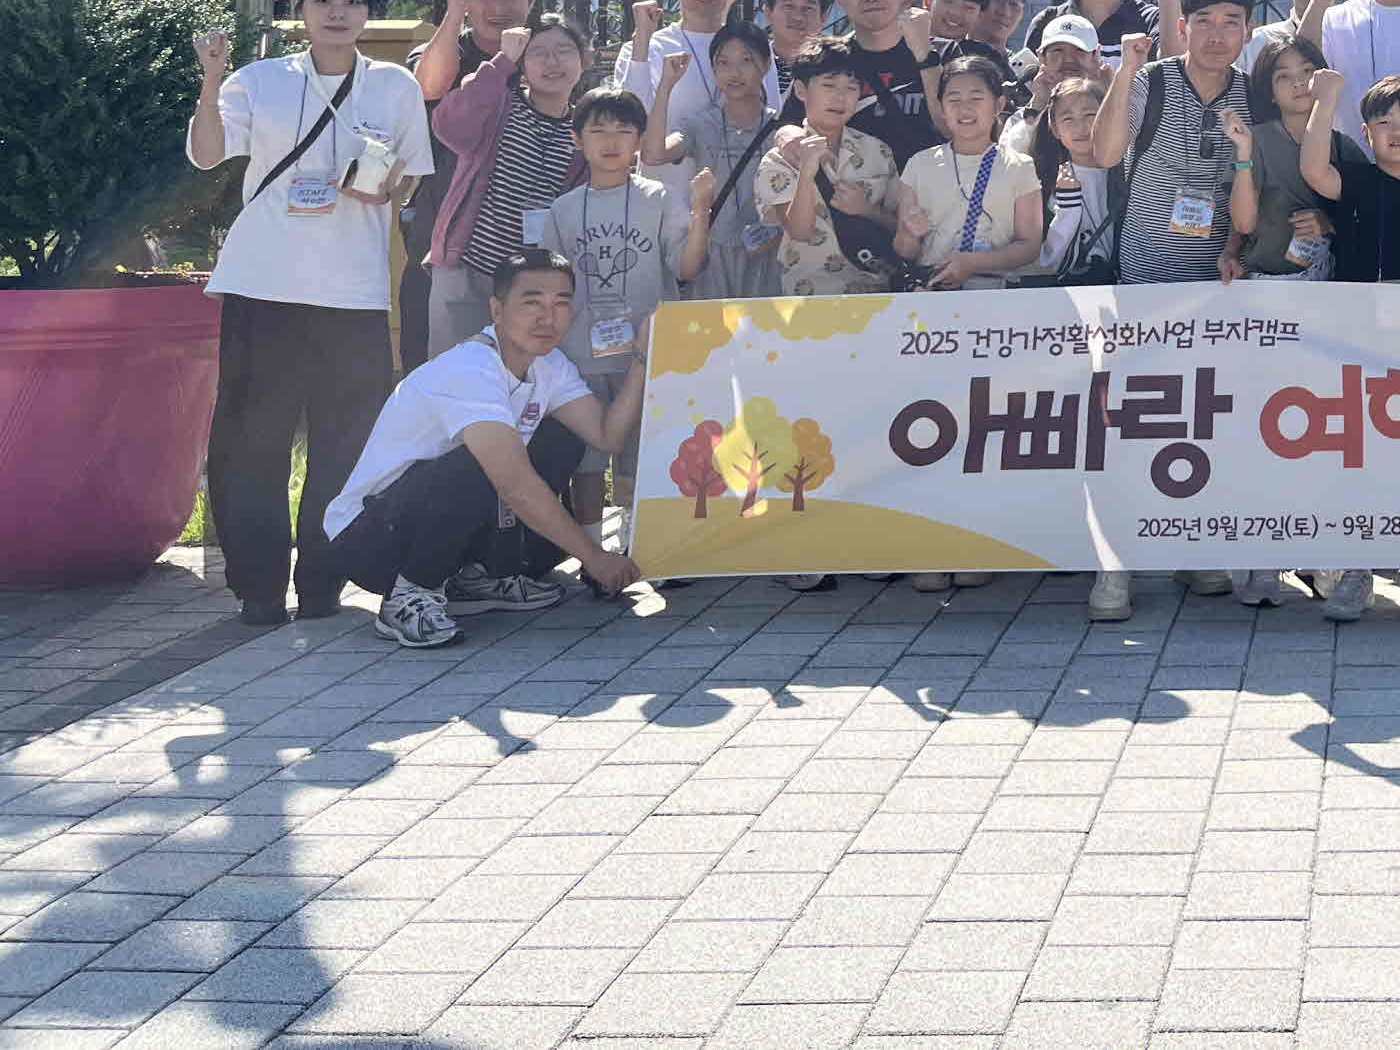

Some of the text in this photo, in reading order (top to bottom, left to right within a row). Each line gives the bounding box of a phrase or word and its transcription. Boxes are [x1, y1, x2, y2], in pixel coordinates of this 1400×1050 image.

[599, 245, 612, 259] H
[900, 316, 1301, 359] 2025 건강가정활성화사업 부자캠프
[888, 366, 1234, 499] 아빠랑
[1136, 516, 1201, 542] 2025년
[1206, 515, 1239, 541] 9월
[1243, 514, 1319, 541] 27일(토)
[1342, 514, 1375, 541] 9월
